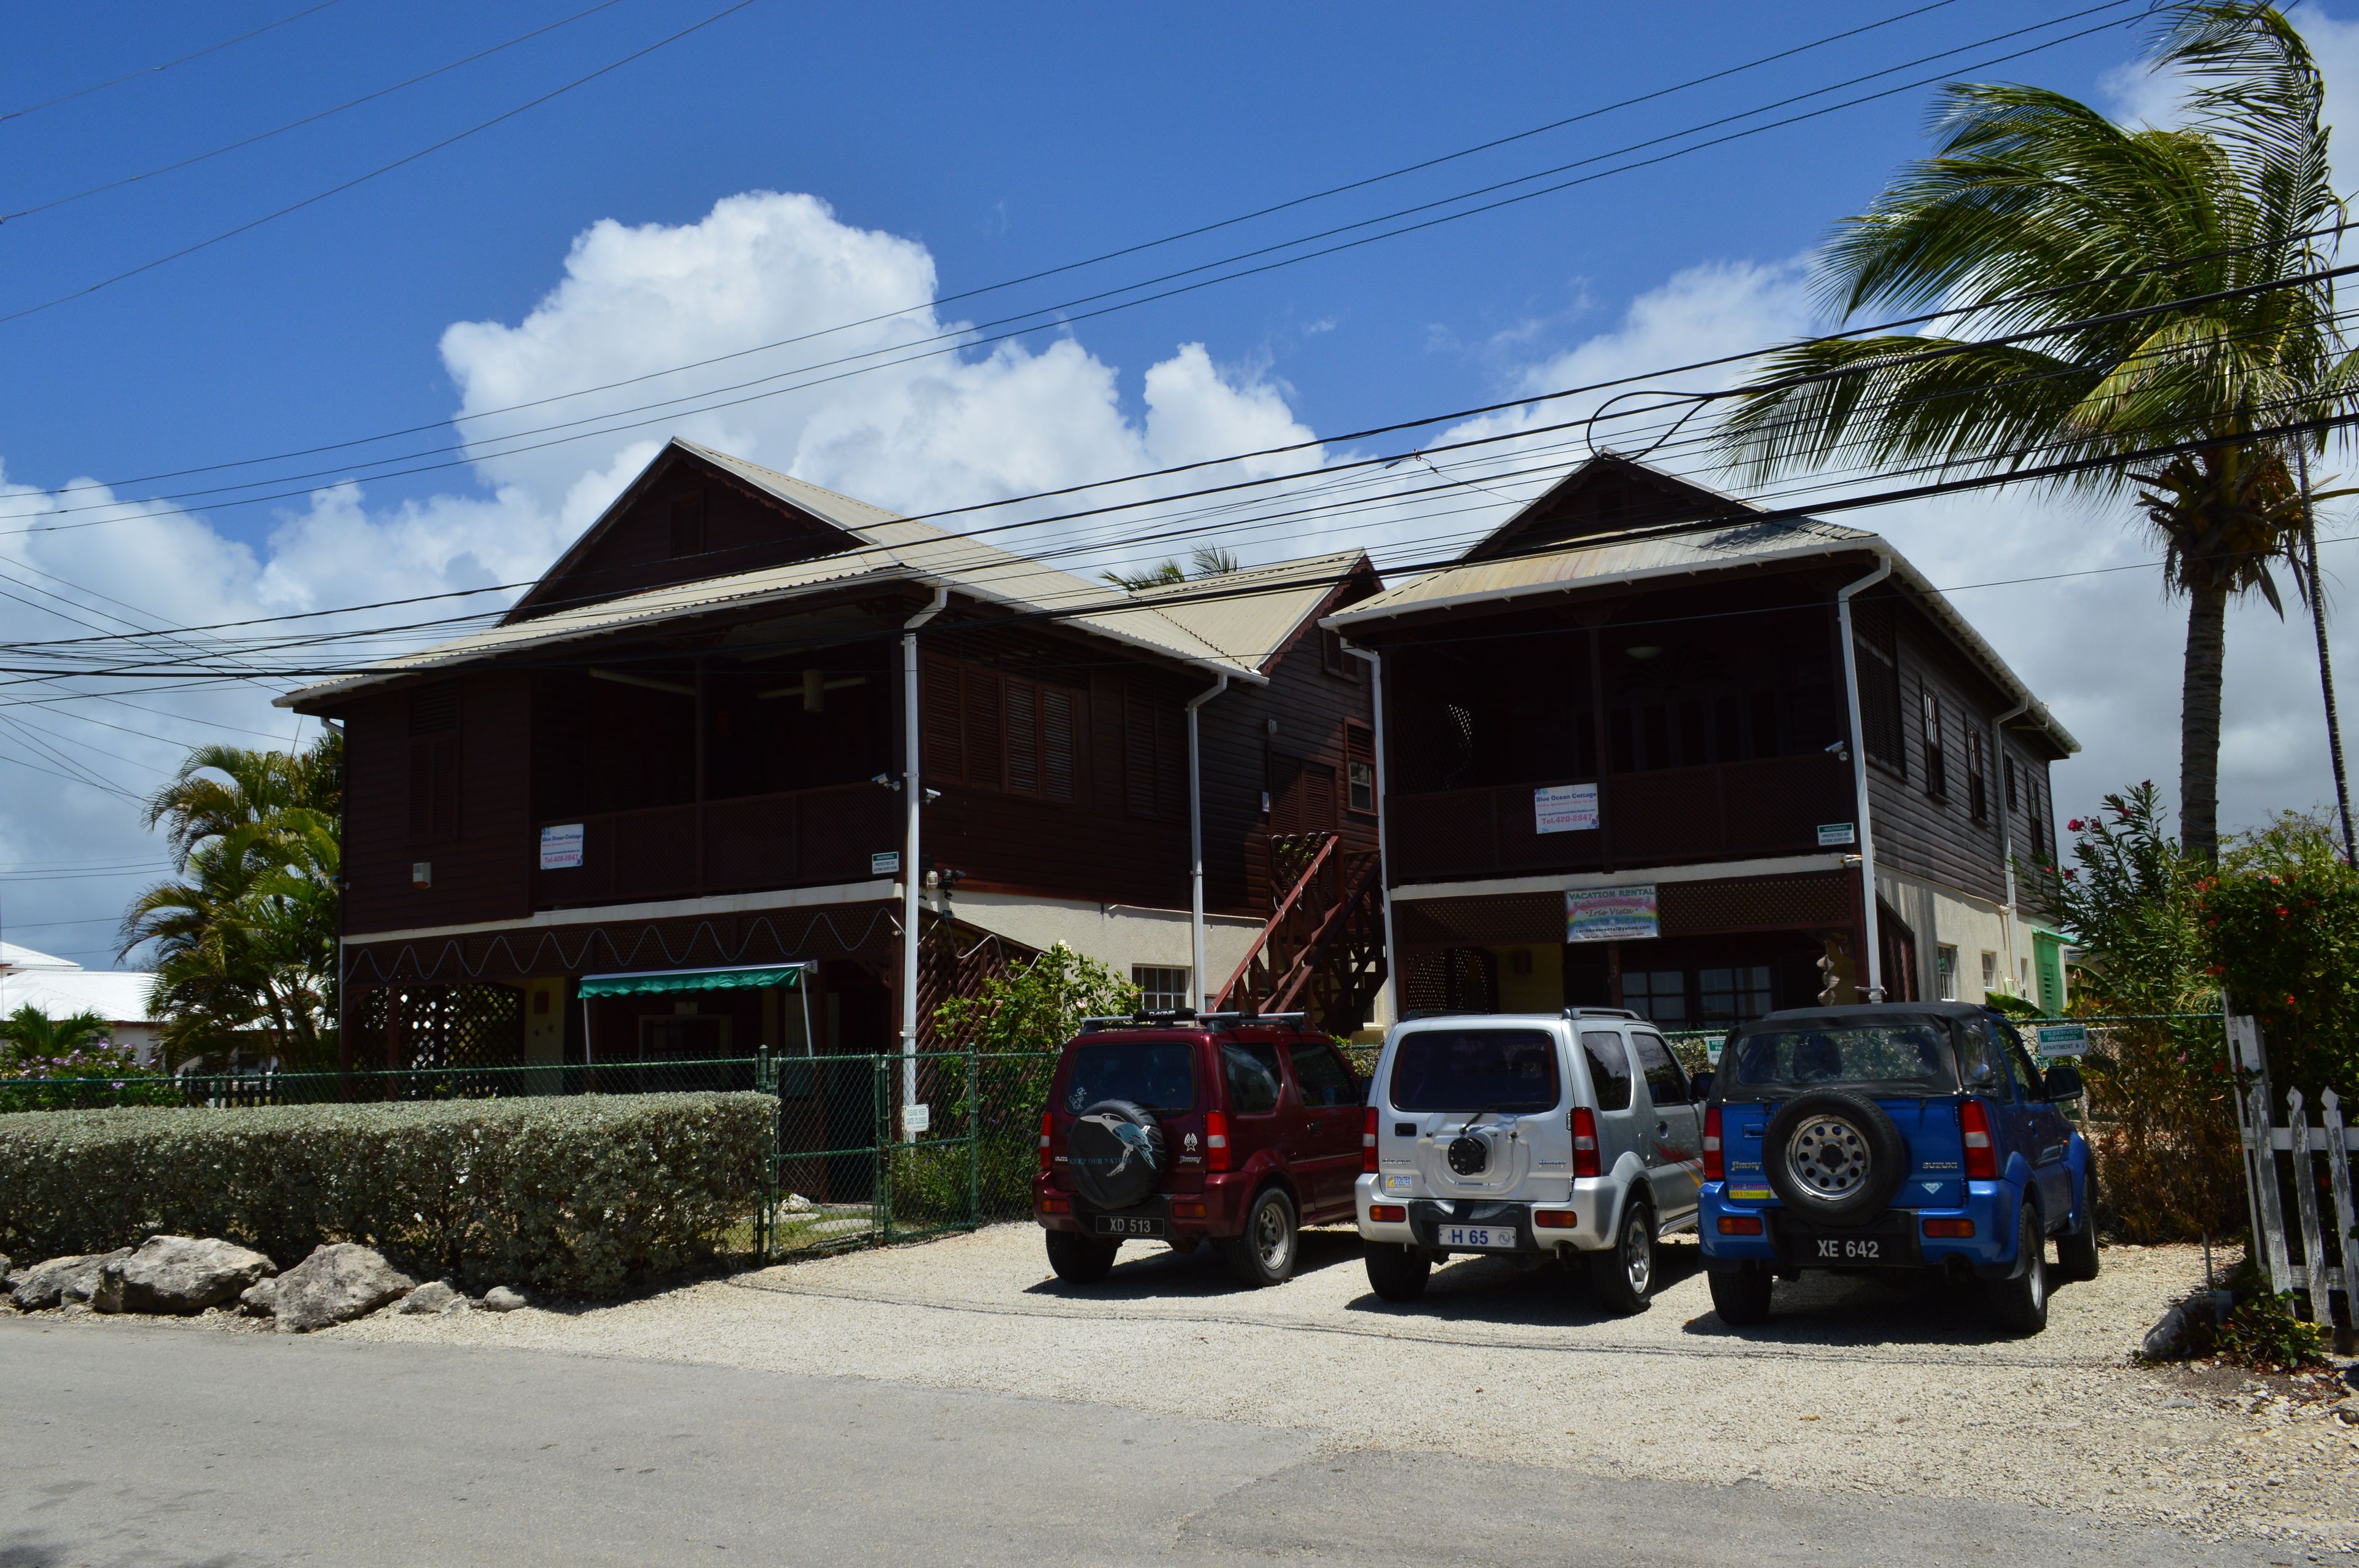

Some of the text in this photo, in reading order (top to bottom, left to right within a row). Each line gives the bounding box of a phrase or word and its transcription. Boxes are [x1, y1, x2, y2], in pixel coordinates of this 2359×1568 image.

[1569, 888, 1655, 900] VACATION RENTAL
[1109, 1218, 1151, 1233] XD 513
[1452, 1229, 1463, 1244] H
[1469, 1230, 1489, 1245] 65
[1817, 1239, 1879, 1258] XE 642
